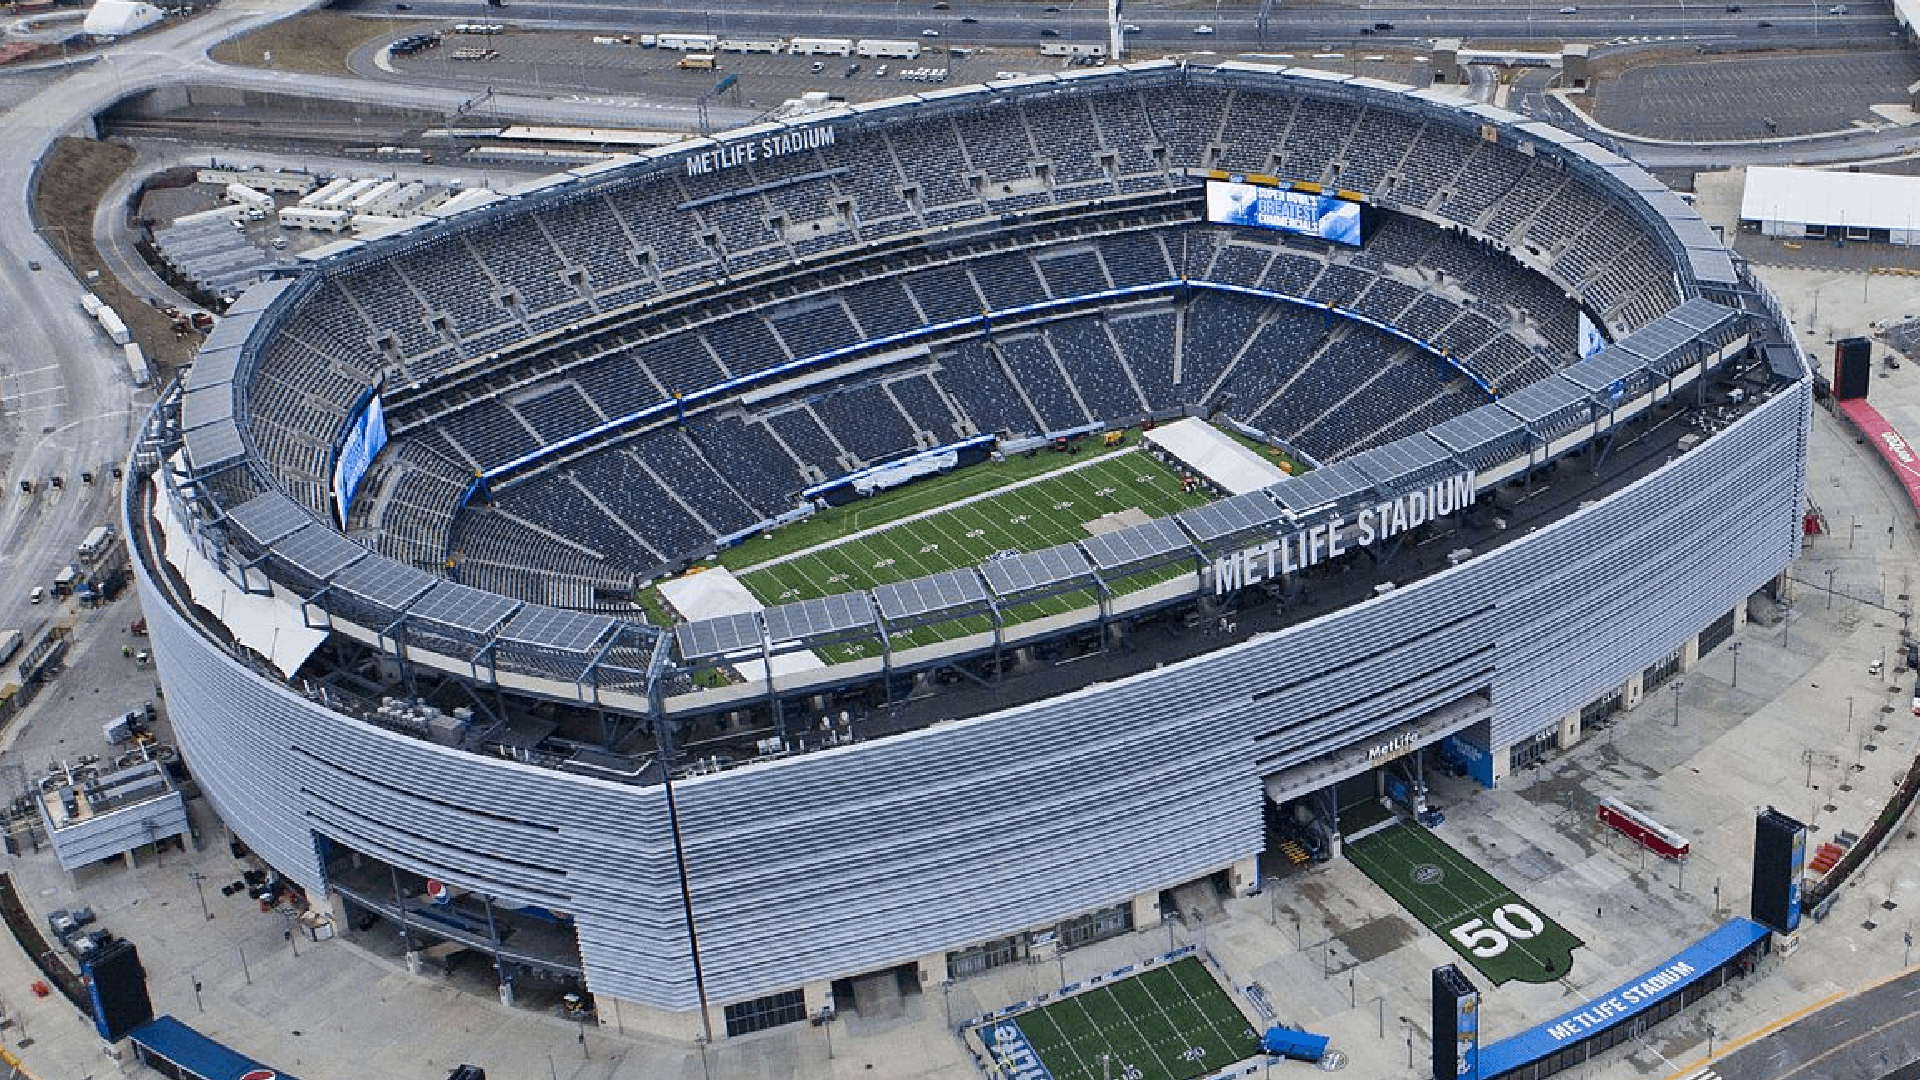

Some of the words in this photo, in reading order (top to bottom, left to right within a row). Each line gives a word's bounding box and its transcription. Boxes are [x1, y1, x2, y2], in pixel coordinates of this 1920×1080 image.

[686, 142, 758, 176] METLIFE
[763, 125, 835, 158] STADIUM
[1215, 518, 1346, 596] METLIFE
[1358, 470, 1477, 546] STADIUM
[1368, 731, 1419, 760] MetLife
[1449, 903, 1544, 958] 50
[1547, 997, 1629, 1040] METLIFE
[1622, 961, 1695, 1004] STADIUM
